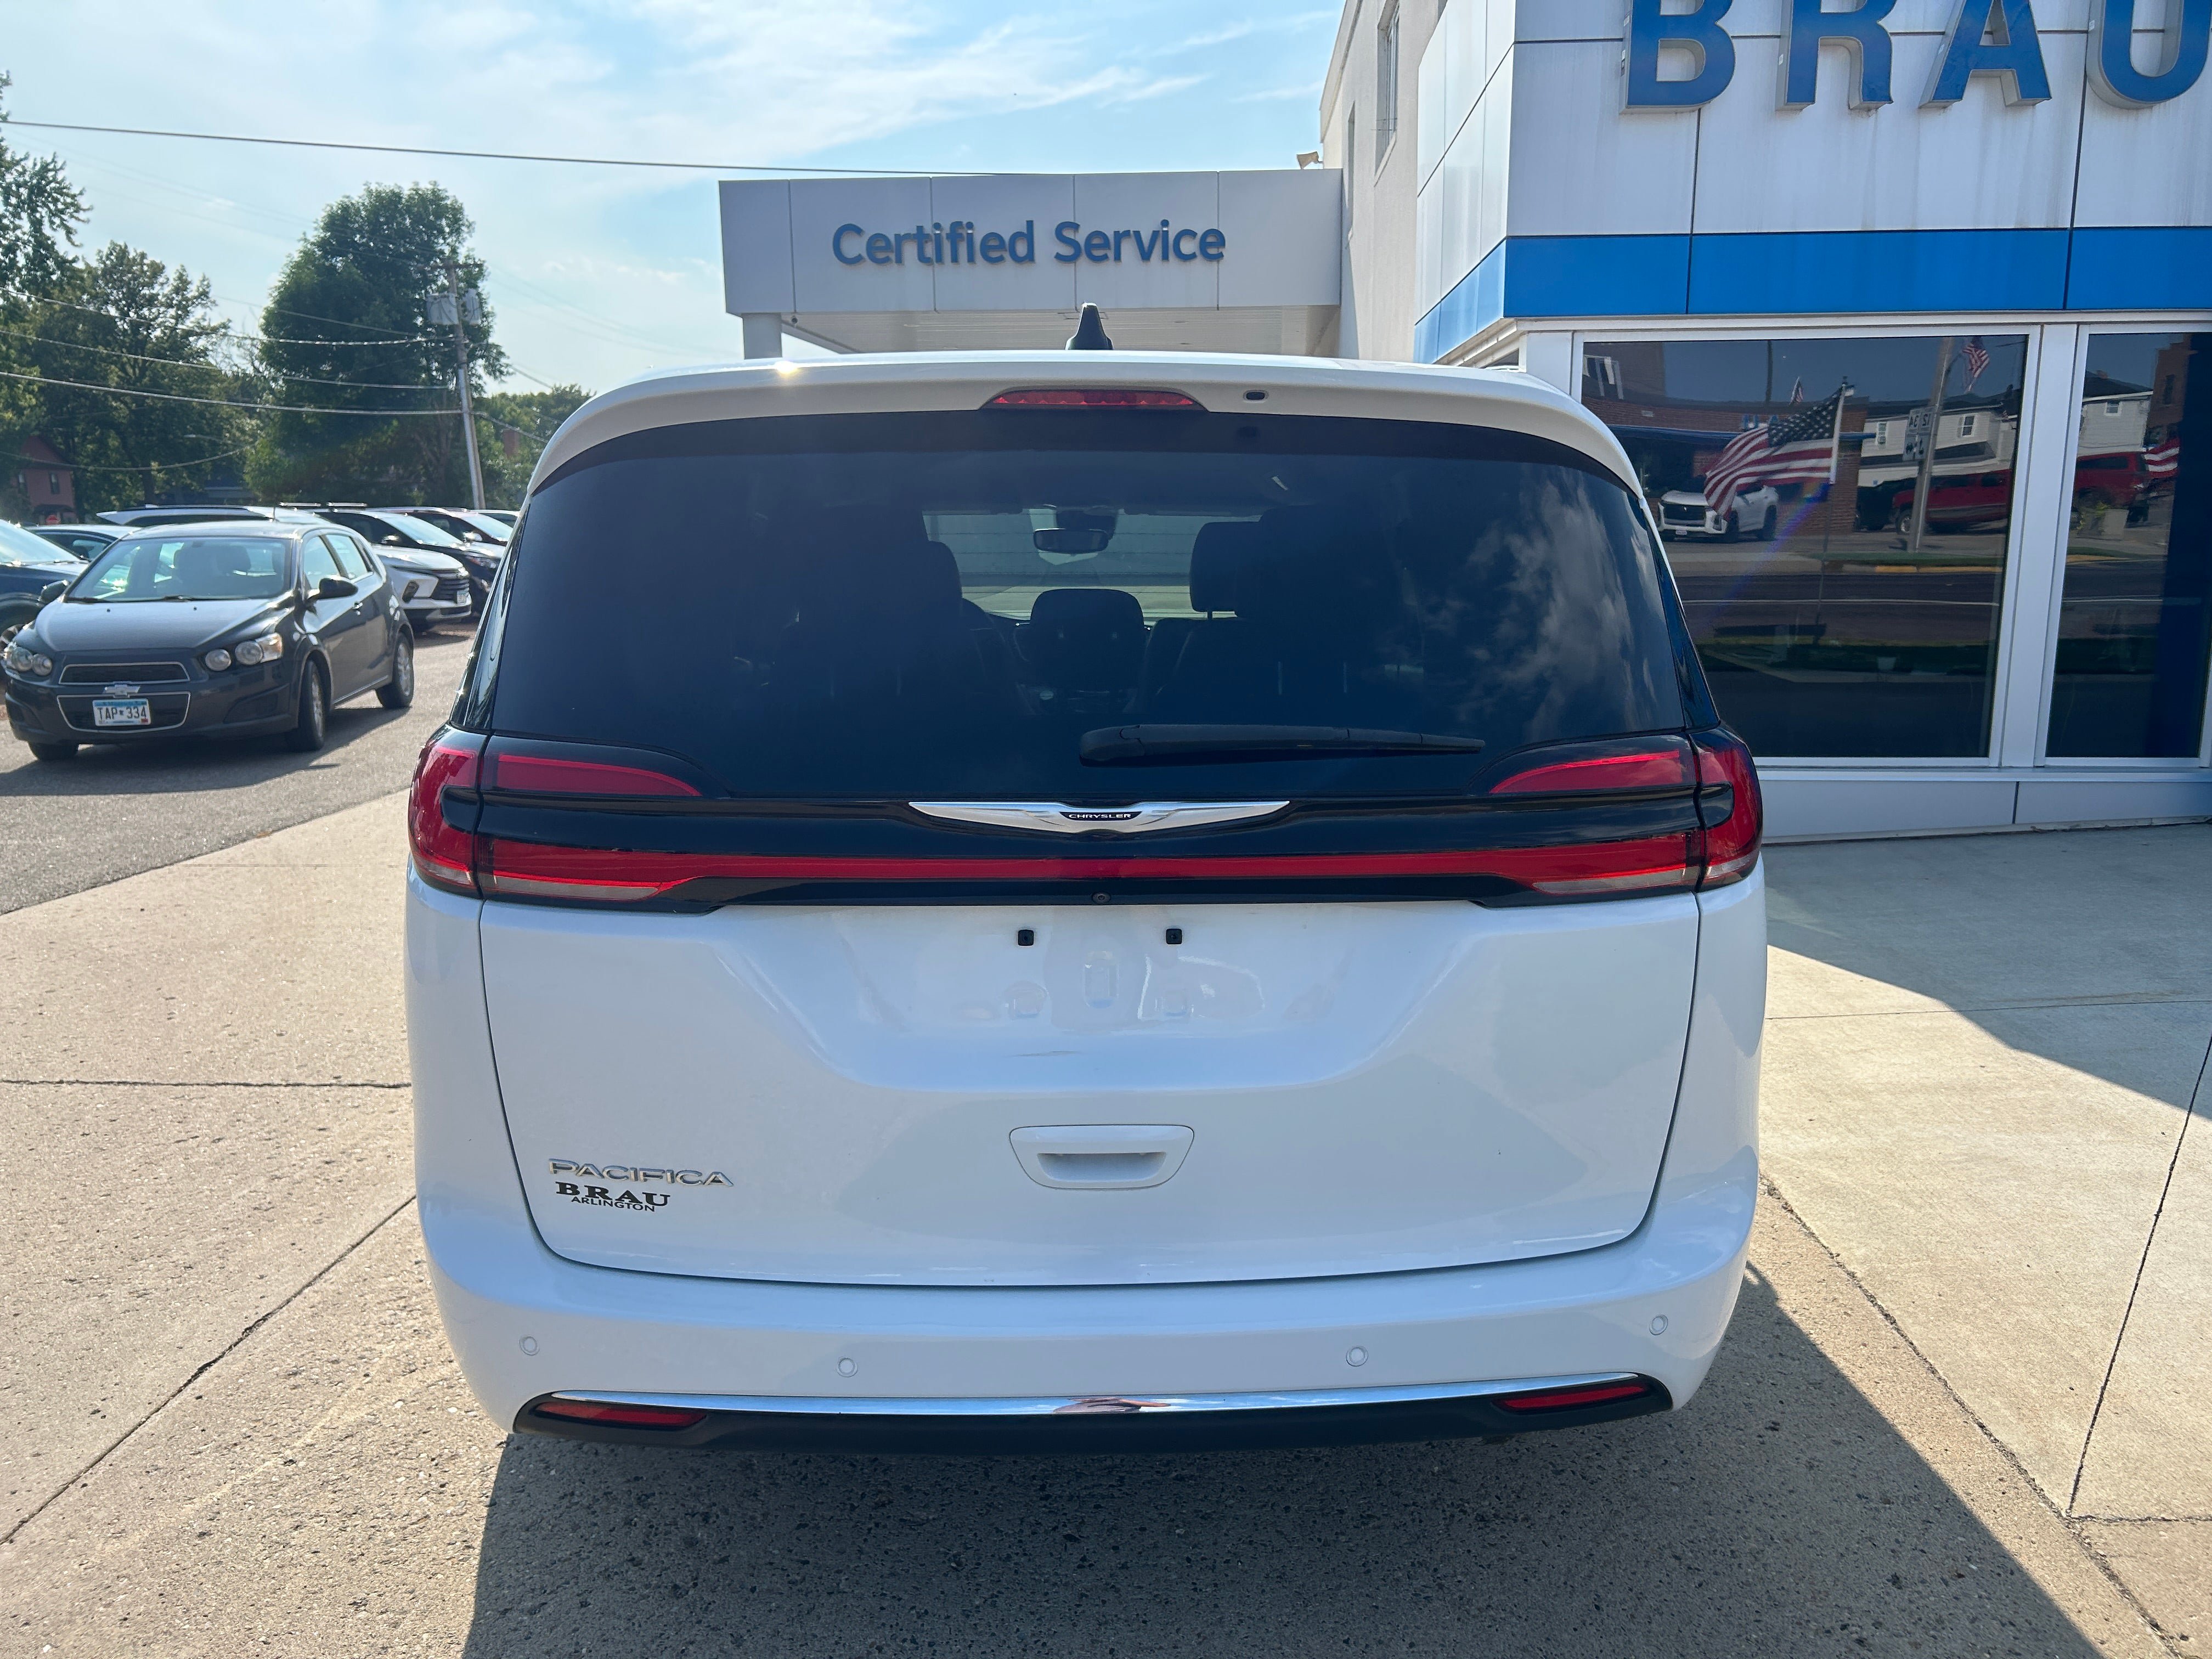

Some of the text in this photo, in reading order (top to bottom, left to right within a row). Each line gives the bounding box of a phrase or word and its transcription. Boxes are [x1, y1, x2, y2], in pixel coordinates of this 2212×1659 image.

[1622, 0, 2211, 111] BRAU
[832, 219, 1226, 266] Certified Service
[97, 707, 118, 720] TAP
[549, 1158, 734, 1187] PACIFICA
[555, 1181, 671, 1207] BRAU
[571, 1196, 656, 1212] ARLINGTON
